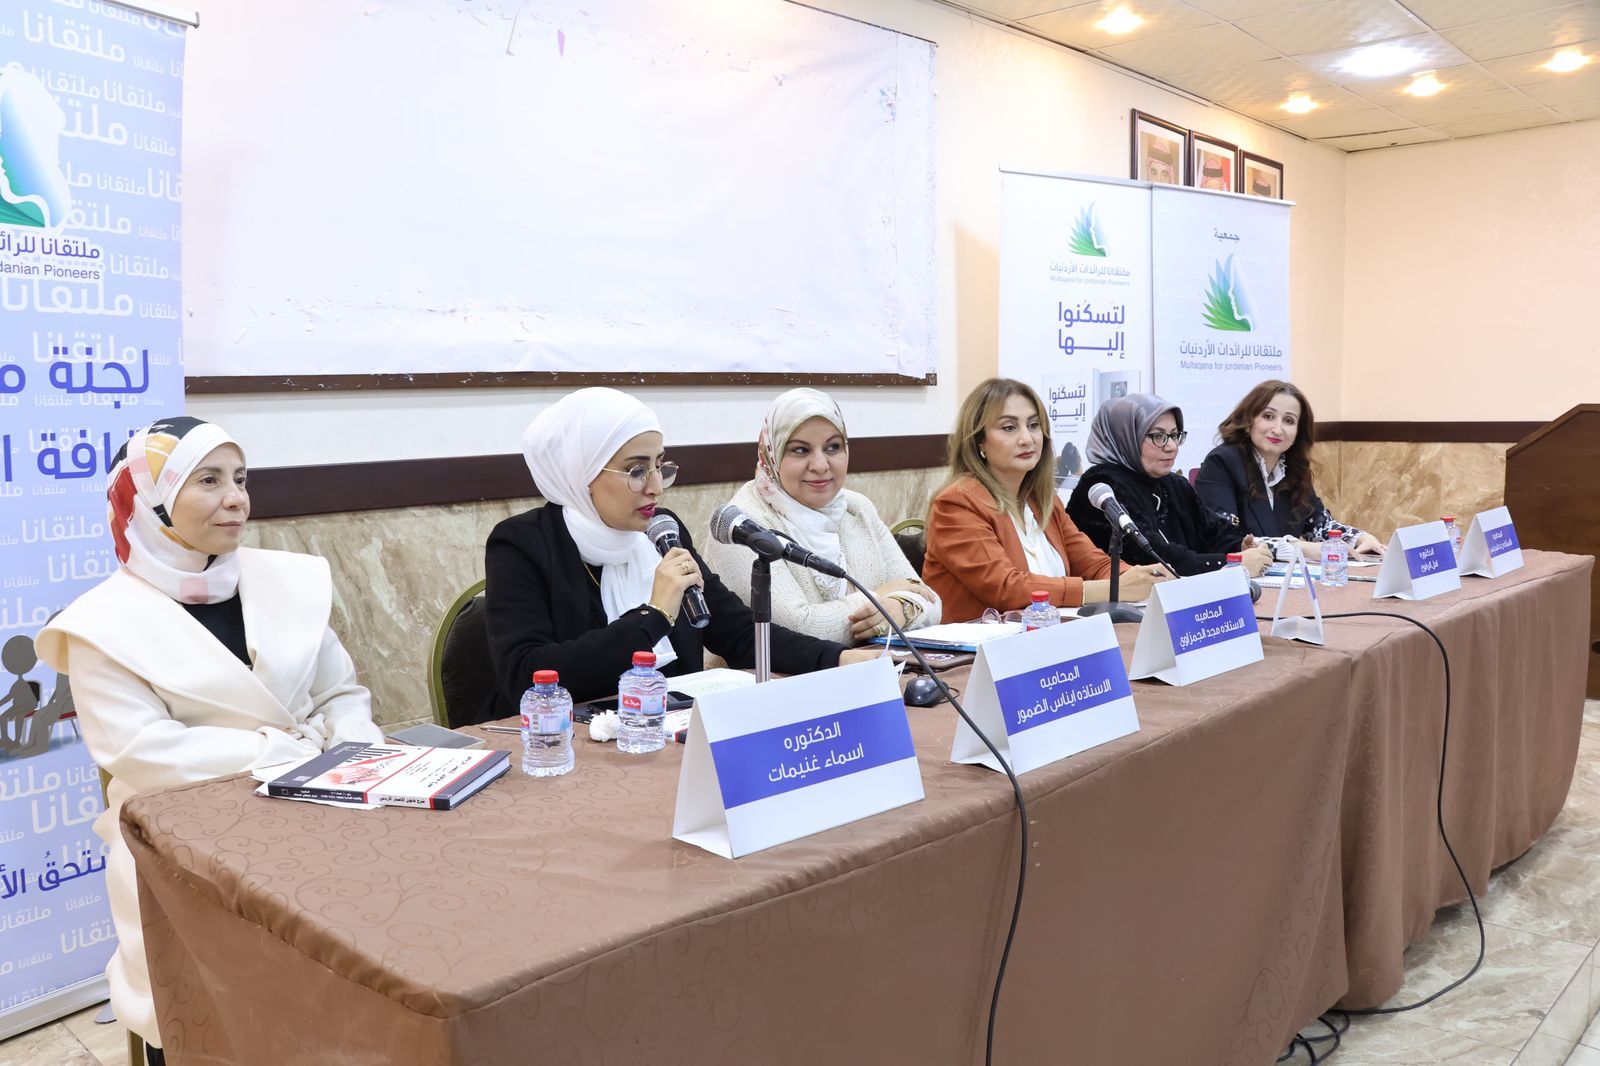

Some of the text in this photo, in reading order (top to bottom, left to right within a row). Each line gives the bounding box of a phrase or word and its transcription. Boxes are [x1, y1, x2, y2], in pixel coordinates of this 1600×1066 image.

[23, 9, 126, 63] ملتقانا
[32, 66, 100, 98] ملتقان
[103, 79, 165, 113] ملتقانا
[134, 133, 177, 157] ملتقانا
[96, 173, 145, 196] ملتقانا
[64, 200, 132, 235] ملتق
[41, 236, 100, 259] ملتقانا
[0, 261, 100, 280] anian Pioneers
[109, 253, 170, 279] ملتقانا
[139, 302, 179, 320] ملتقانا
[1253, 344, 1282, 357] ملتقانا
[49, 346, 149, 409] لجنة
[37, 429, 140, 480] افة
[21, 515, 104, 544] ملتقانا
[48, 549, 115, 583] تقانا
[1194, 605, 1223, 624] المحاميه
[1039, 664, 1081, 690] المحاميه
[1016, 678, 1112, 725] الاستاذه ايناس الضمور
[783, 721, 842, 753] الدكتوره
[66, 762, 99, 787] قانا
[768, 742, 865, 783] اسماء غنيمات
[31, 785, 102, 834] قانا
[0, 905, 52, 932] ملتقان
[60, 918, 119, 954] تقانا
